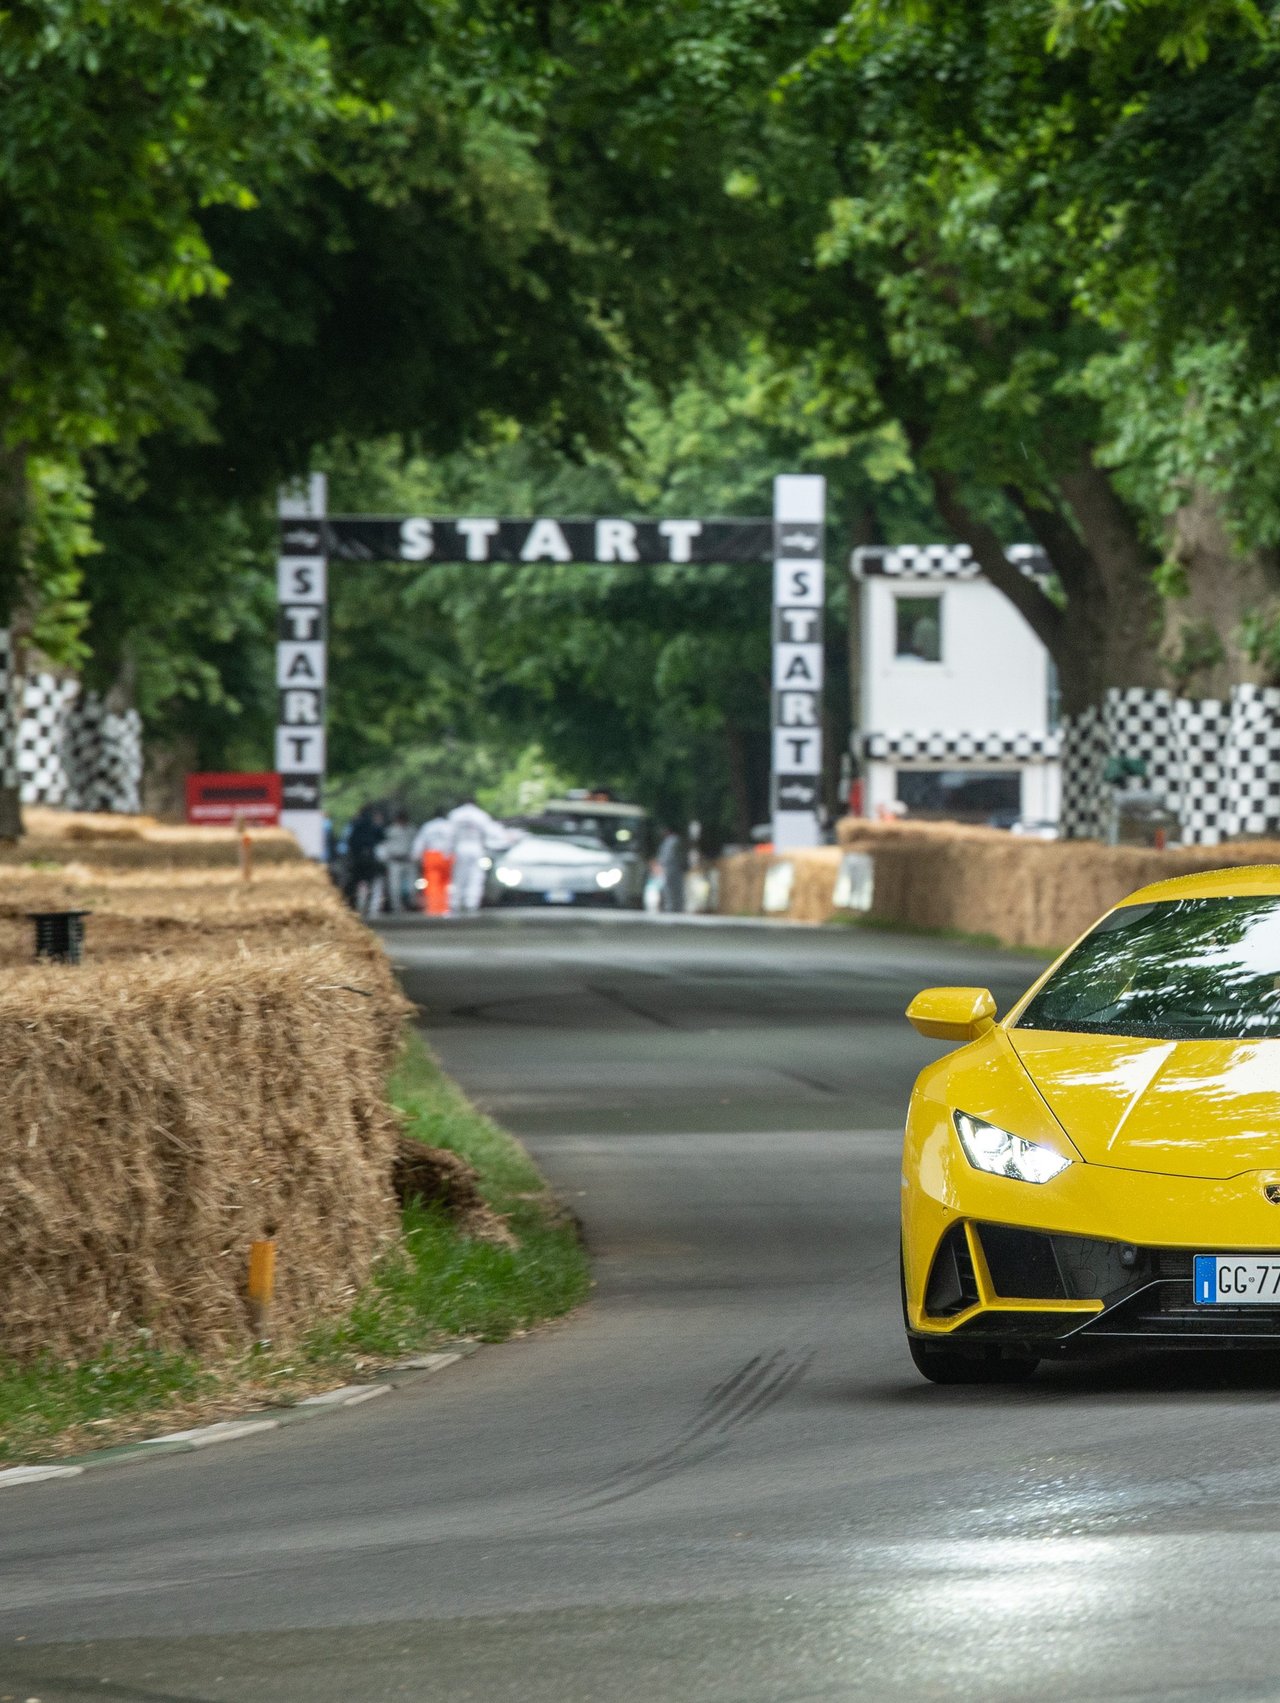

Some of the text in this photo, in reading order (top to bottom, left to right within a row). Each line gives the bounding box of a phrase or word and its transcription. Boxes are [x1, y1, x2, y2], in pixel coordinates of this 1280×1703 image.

[401, 517, 701, 562] START
[284, 568, 319, 762] START
[781, 572, 817, 763] START
